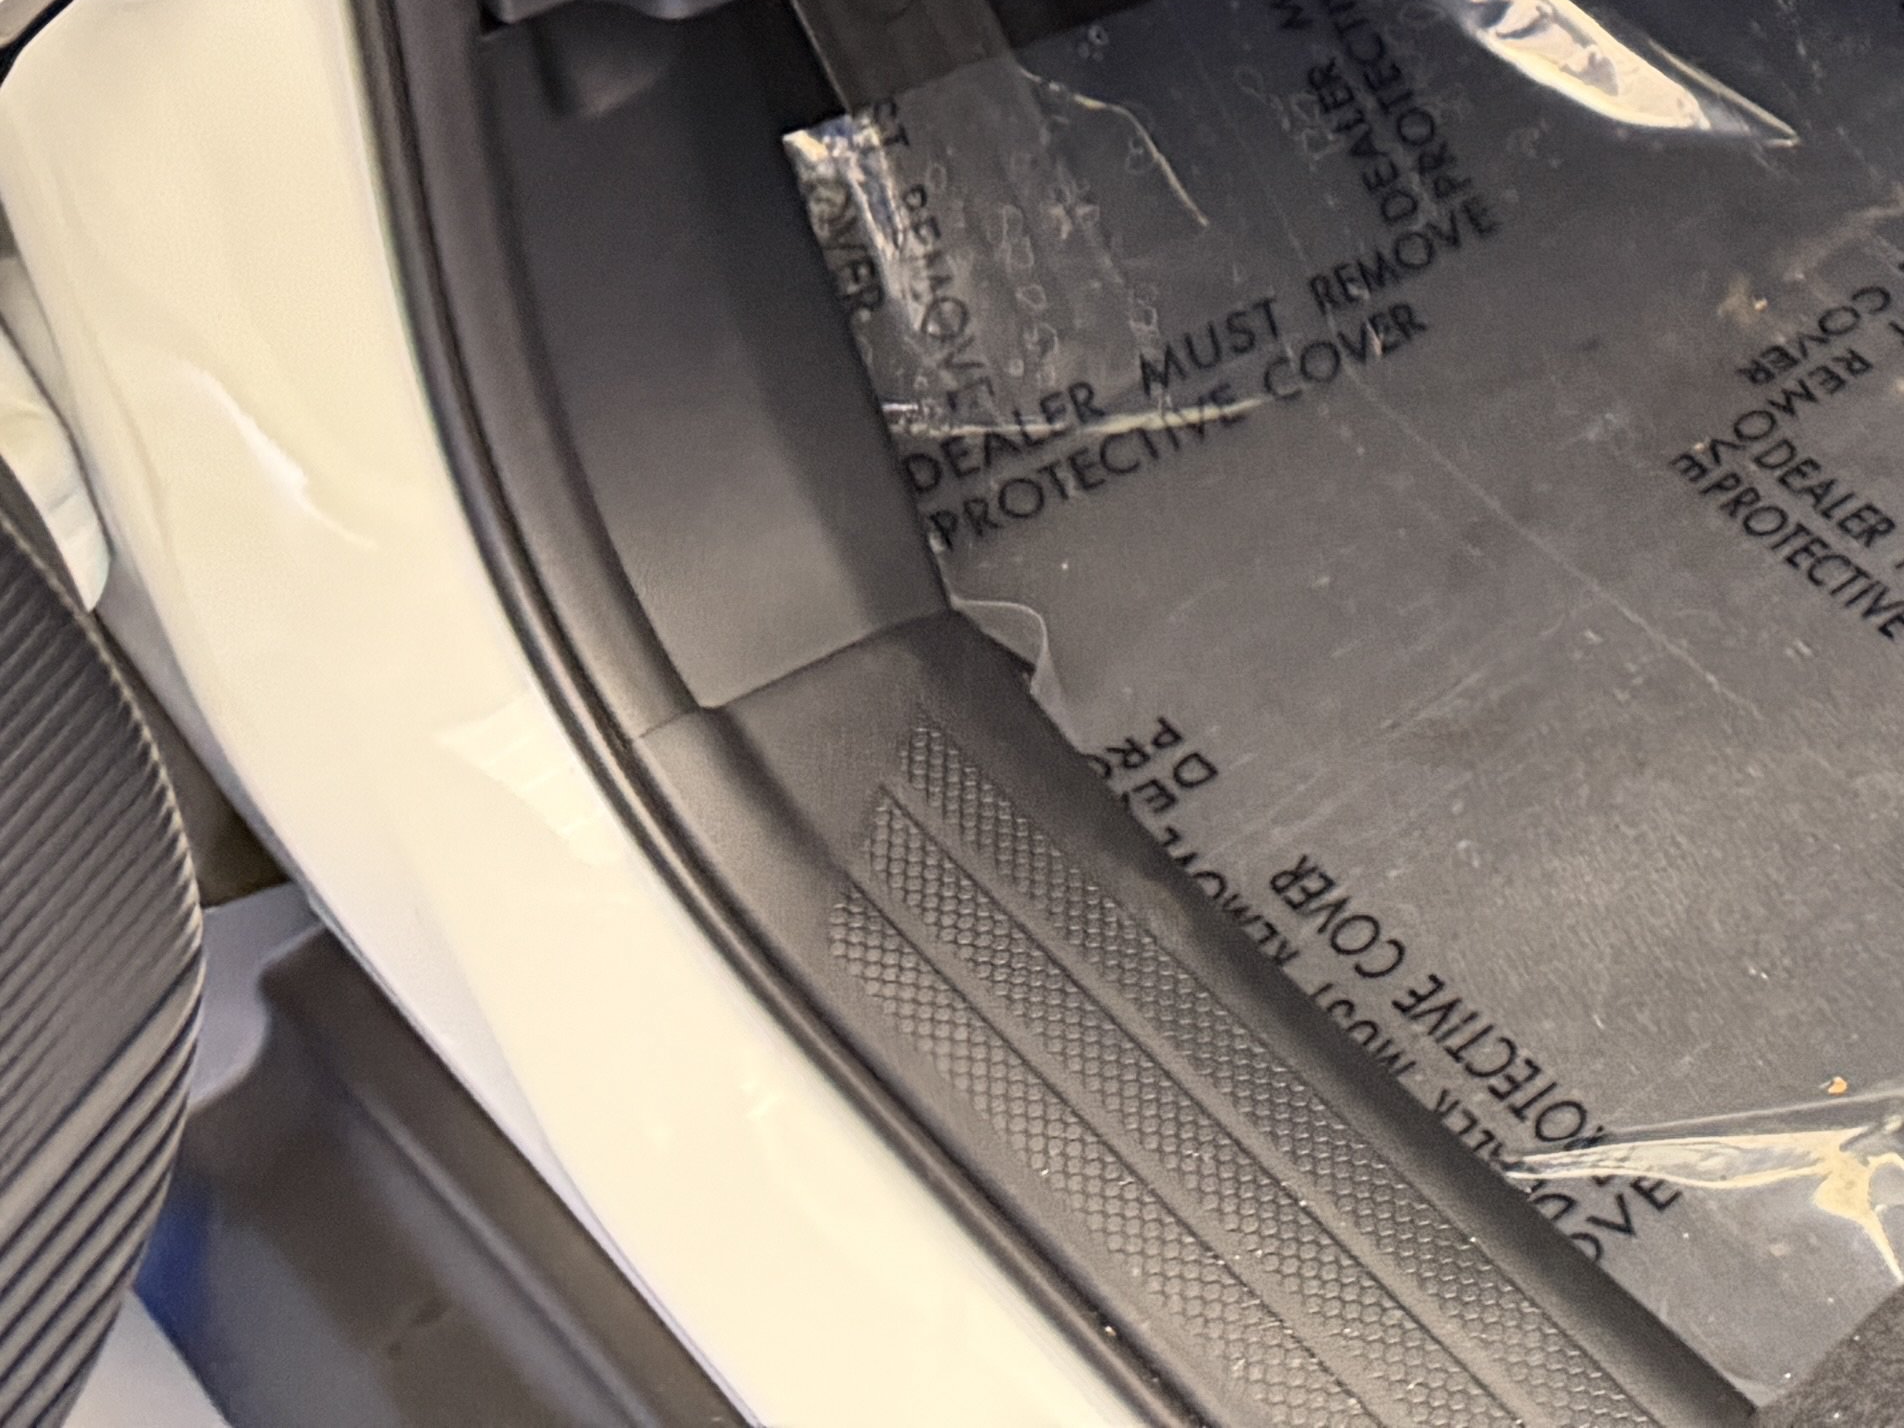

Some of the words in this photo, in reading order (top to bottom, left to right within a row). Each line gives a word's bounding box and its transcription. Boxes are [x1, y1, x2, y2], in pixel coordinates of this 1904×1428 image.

[902, 380, 1103, 495] DEALER
[1139, 296, 1282, 397] MUST
[1311, 194, 1502, 316] REMOVE
[1735, 285, 1892, 386] COVER
[928, 383, 1252, 553] PROTECTIVE
[1262, 300, 1430, 401] COVER
[1668, 348, 1873, 483] REMOVE
[1754, 438, 1897, 549] DEALER
[1269, 854, 1406, 978] COVER
[1391, 972, 1606, 1152] OTECTIVE
